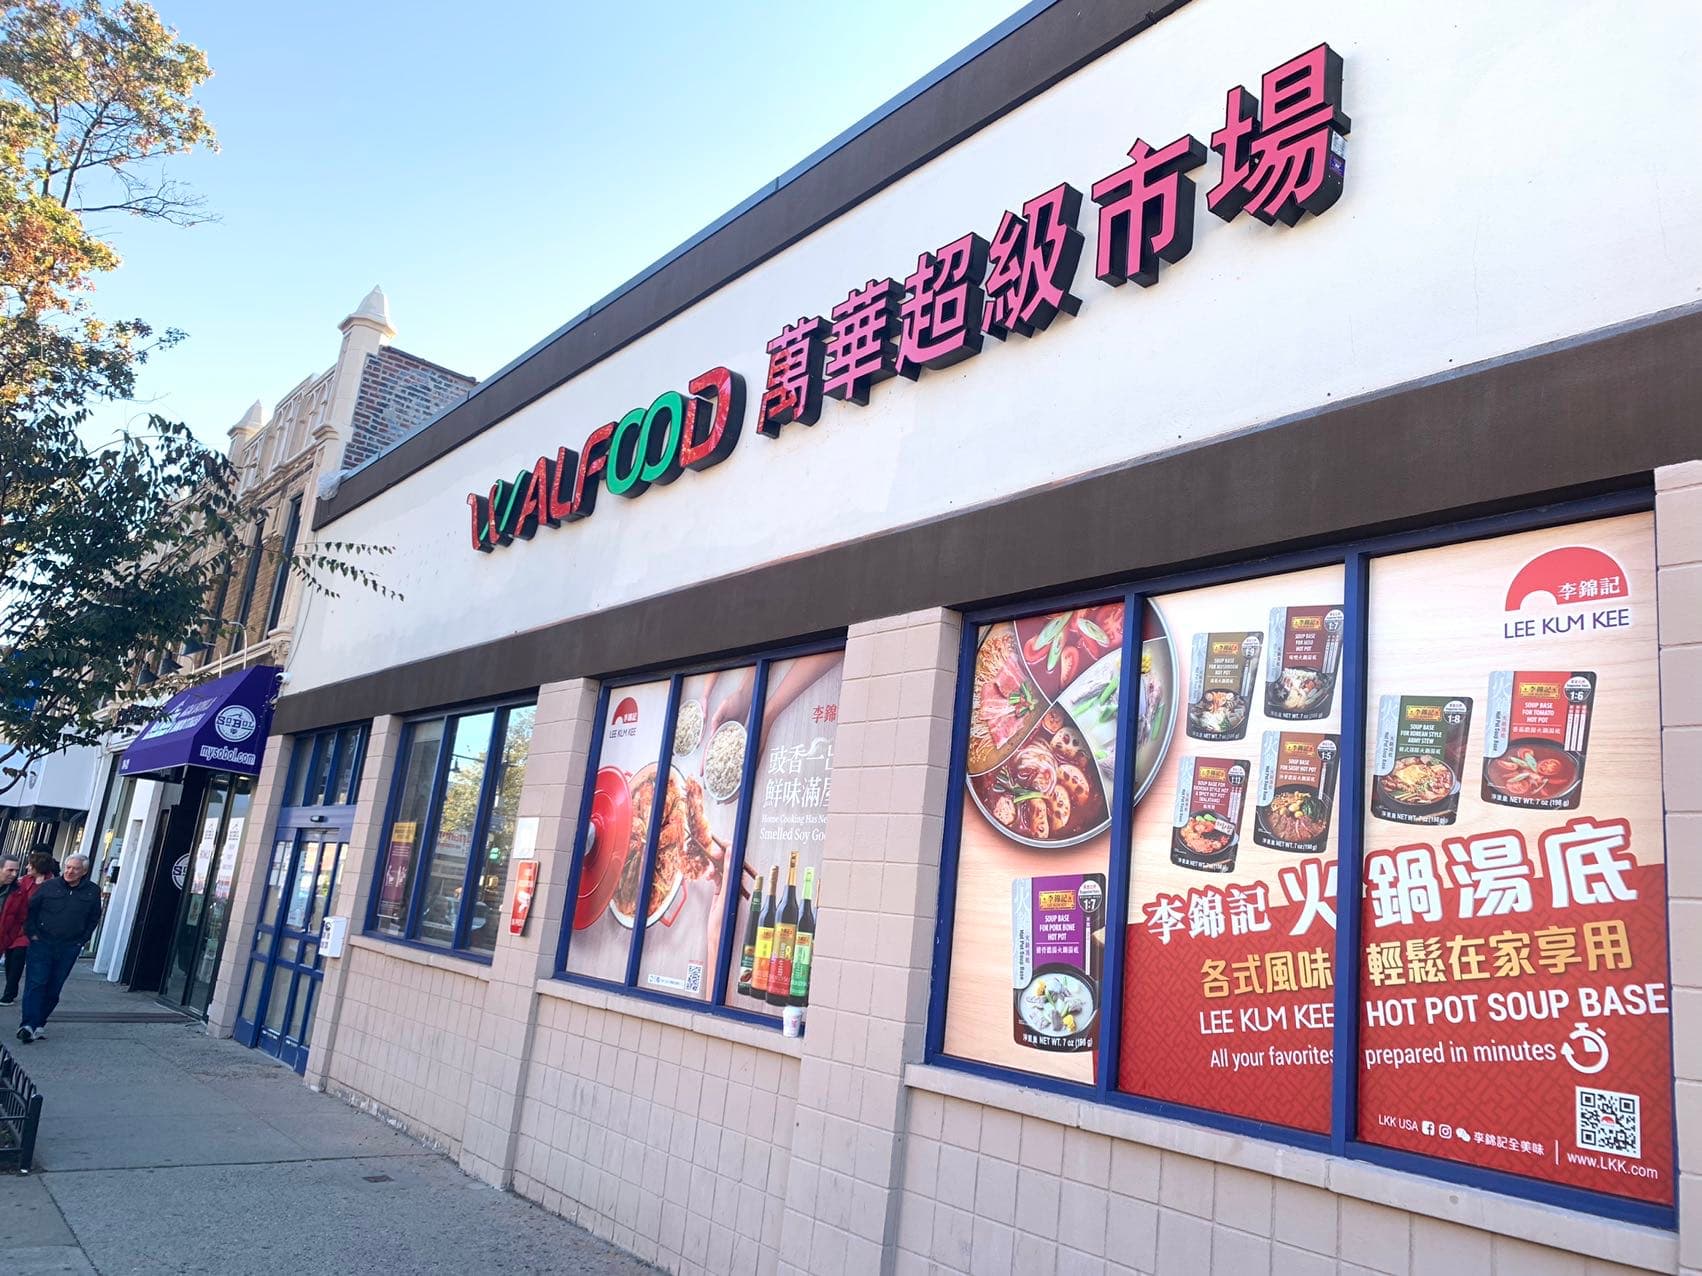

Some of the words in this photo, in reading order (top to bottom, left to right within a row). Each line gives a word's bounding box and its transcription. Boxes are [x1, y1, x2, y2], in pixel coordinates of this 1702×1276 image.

[756, 42, 1351, 437] 萬華超級市場
[467, 366, 744, 553] WALFOOD
[1557, 576, 1620, 600] 李錦記
[1504, 620, 1535, 639] LEE
[1542, 613, 1584, 635] KUM
[1592, 608, 1630, 630] KEE
[200, 744, 256, 766] mysobol.com
[780, 814, 804, 826] Cooking
[760, 827, 793, 841] Smelled
[794, 828, 811, 845] Soy
[1044, 914, 1057, 923] SOUP
[1057, 914, 1070, 922] BASE
[1147, 885, 1272, 945] 李錦記
[1200, 947, 1334, 998] 各式風味
[1366, 919, 1633, 987] 輕鬆在家享用
[1200, 1009, 1235, 1035] LEE
[1240, 1005, 1288, 1032] KUM
[1294, 1003, 1334, 1029] KEE
[1366, 999, 1417, 1027] HOT
[1425, 994, 1479, 1024] POT
[1487, 988, 1570, 1021] SOUP
[1578, 983, 1669, 1017] BASE
[1210, 1048, 1229, 1068] All
[1232, 1051, 1265, 1072] your
[1365, 1041, 1445, 1069] prepared
[1449, 1040, 1468, 1062] in
[1474, 1038, 1557, 1062] minutes
[1378, 1114, 1397, 1128] LKK
[1398, 1118, 1419, 1132] USA
[1566, 1151, 1659, 1180] www.LKK.com
